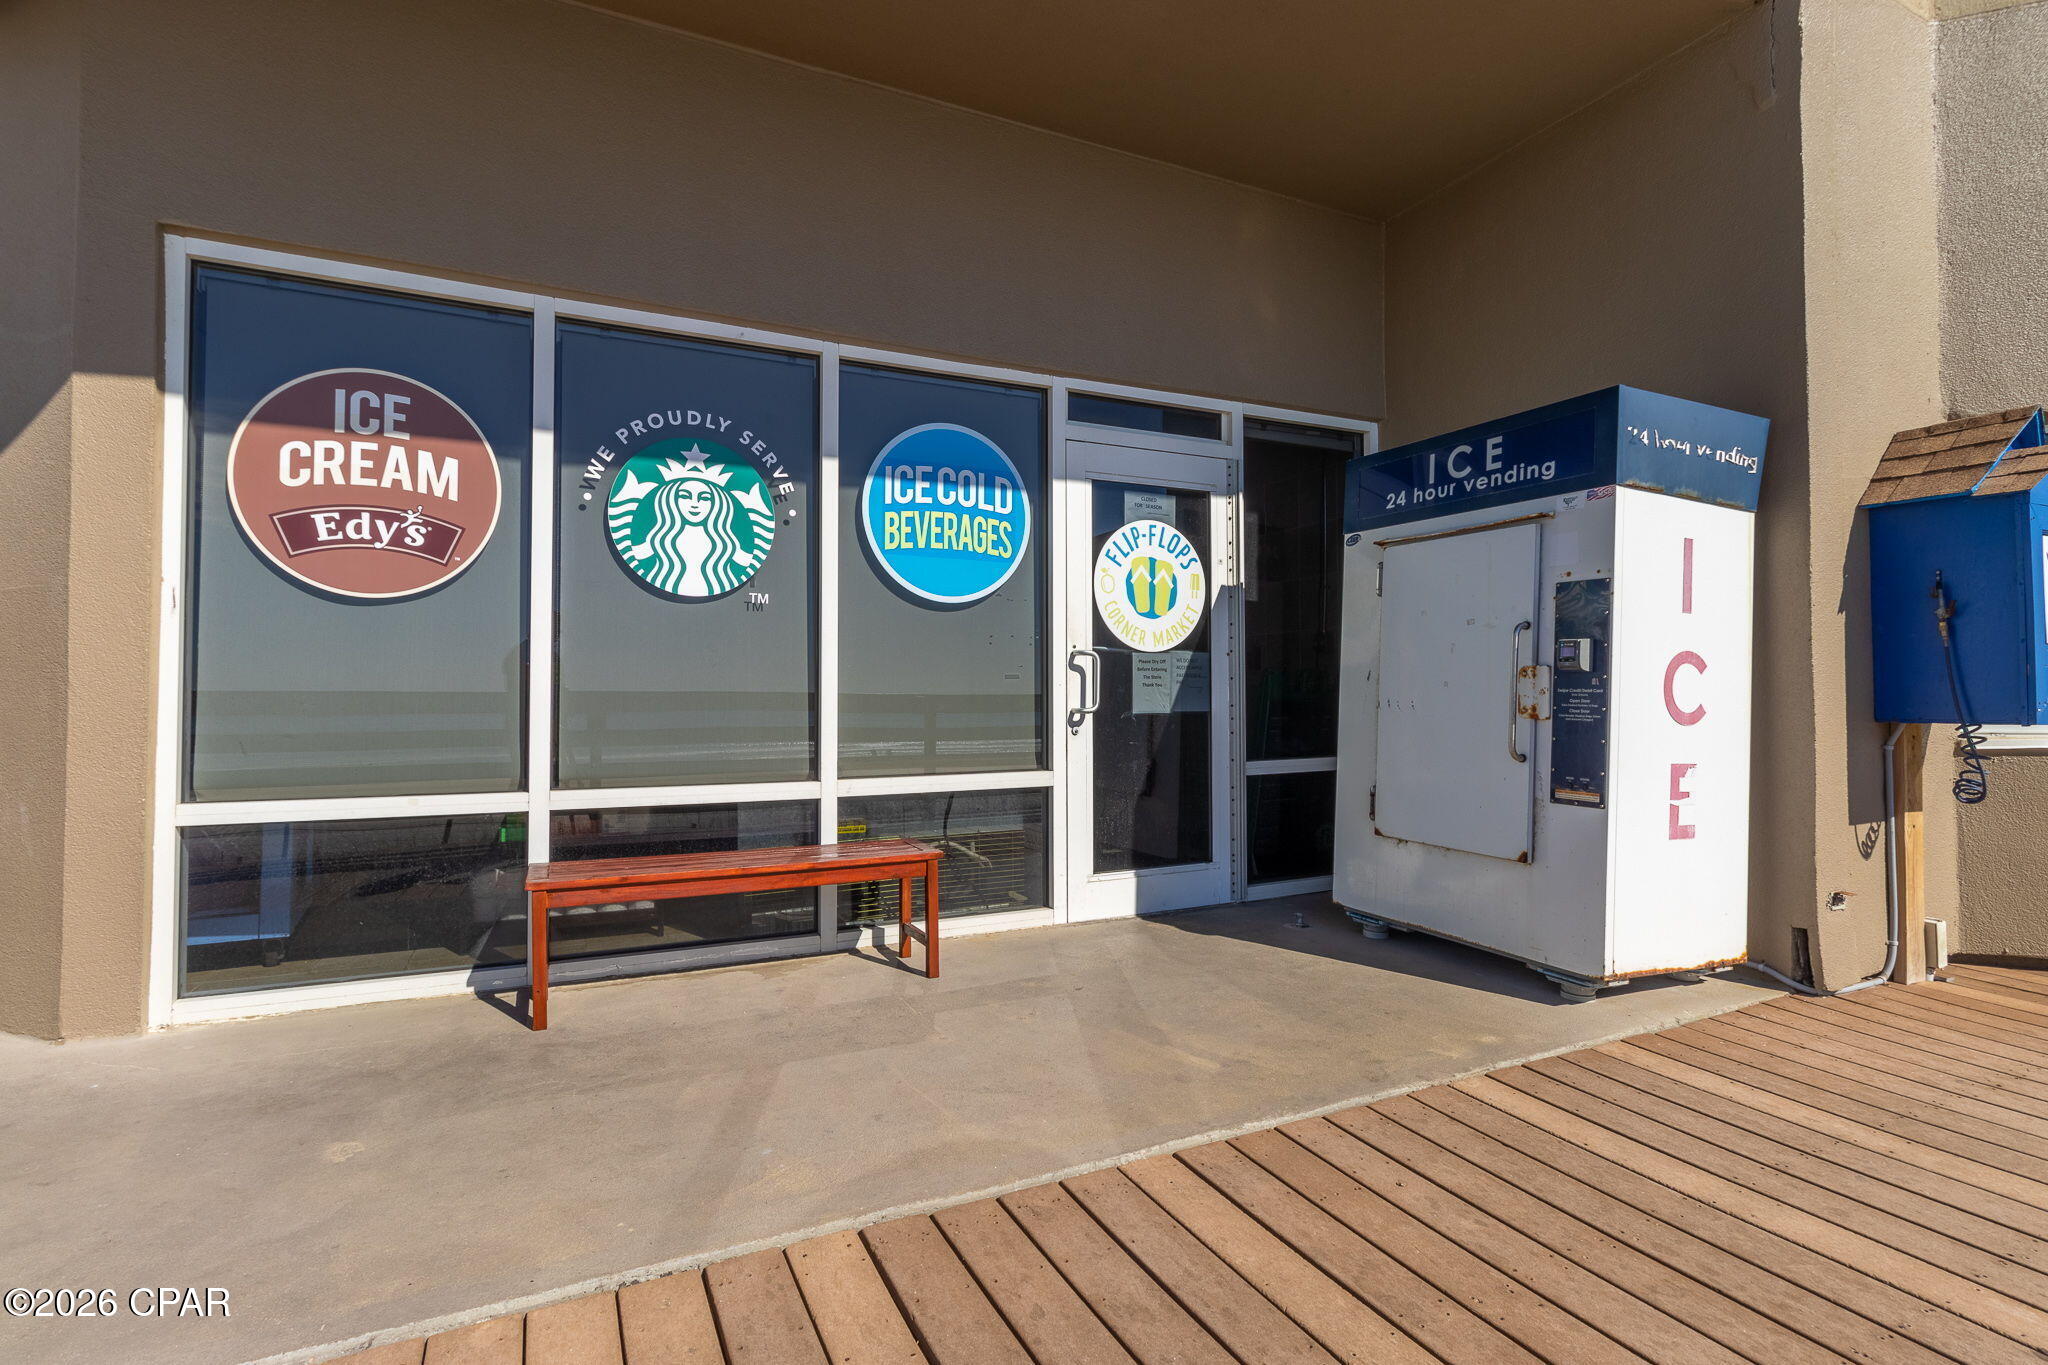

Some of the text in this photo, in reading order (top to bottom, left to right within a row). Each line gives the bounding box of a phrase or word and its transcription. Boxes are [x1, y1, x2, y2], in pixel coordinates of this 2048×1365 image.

[334, 388, 411, 441] ICE
[279, 439, 459, 502] CREAM
[584, 410, 795, 496] WE PROUDLY SERVE
[1429, 436, 1503, 485] ICE
[884, 465, 1013, 515] ICE COLD
[1386, 460, 1556, 509] 24 hour vending
[884, 510, 1013, 559] BEVERAGES
[1105, 525, 1198, 570] FLIP-FLOPS
[1104, 600, 1199, 648] CORNER MARKET
[1662, 537, 1708, 841] ICE
